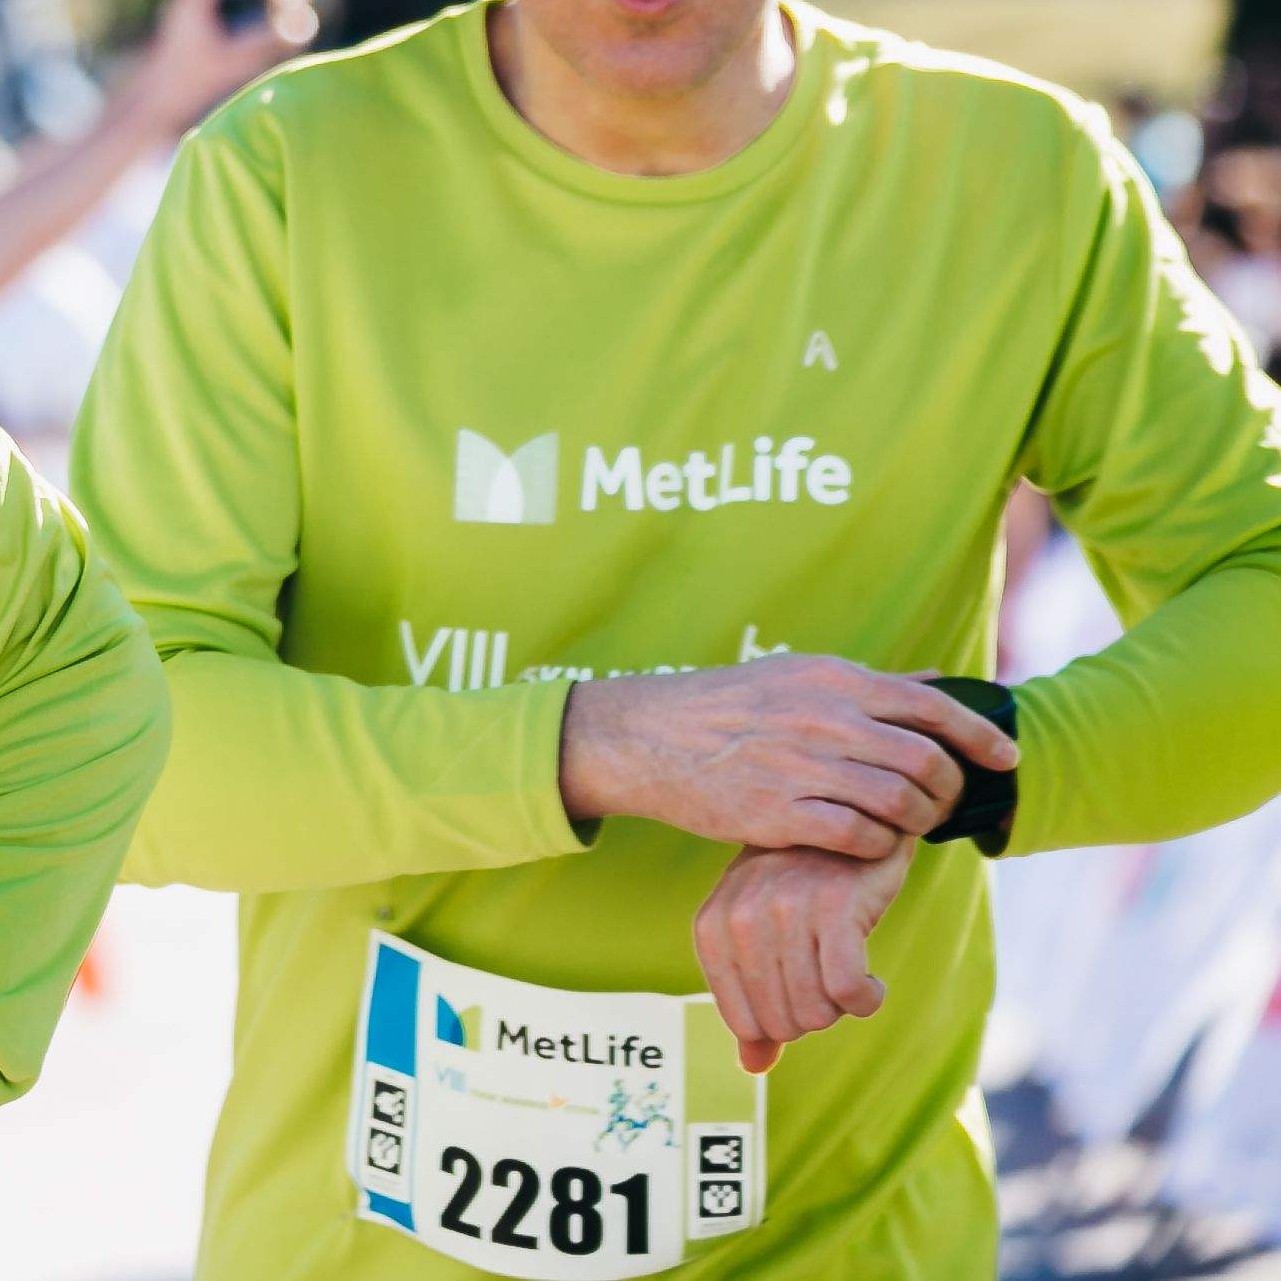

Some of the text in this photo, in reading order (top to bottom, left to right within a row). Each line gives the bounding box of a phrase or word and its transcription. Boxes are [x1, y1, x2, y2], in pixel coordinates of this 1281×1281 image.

[579, 435, 852, 512] MetLife
[400, 620, 509, 692] VIII
[496, 1019, 665, 1070] MetLife
[440, 1145, 651, 1256] 2281
